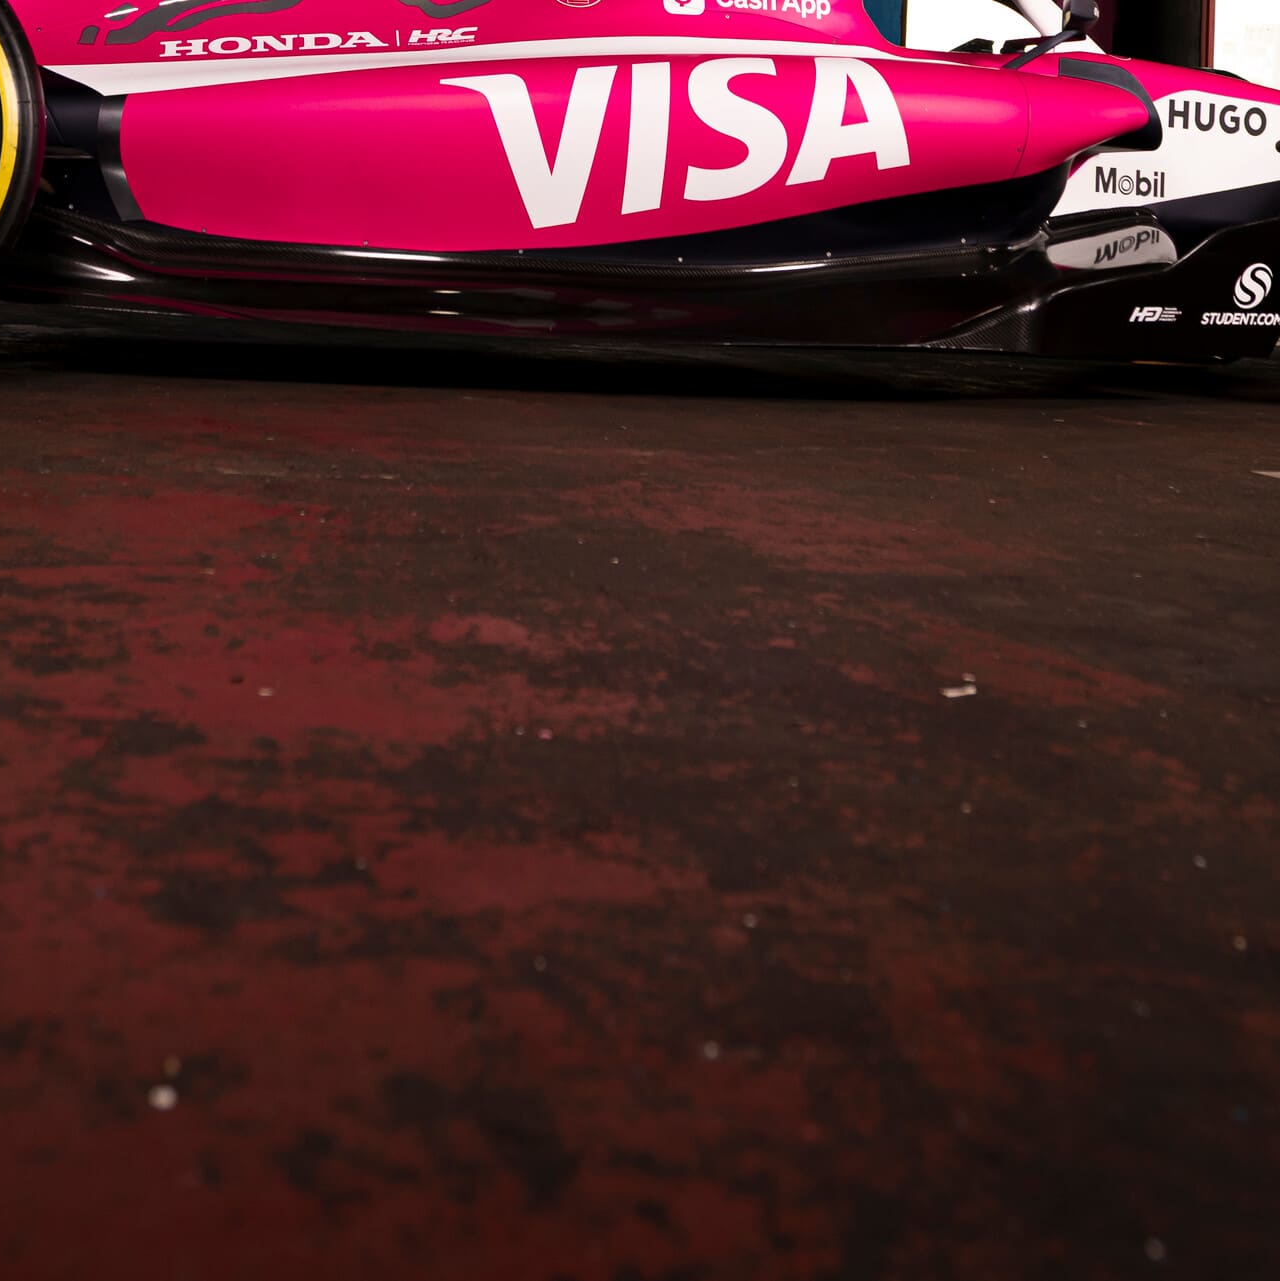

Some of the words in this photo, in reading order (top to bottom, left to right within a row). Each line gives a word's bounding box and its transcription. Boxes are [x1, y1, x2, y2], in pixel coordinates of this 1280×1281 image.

[159, 30, 389, 57] HONDA
[408, 26, 479, 43] HRC
[1167, 99, 1267, 137] HUGO
[439, 57, 911, 229] VISA
[1094, 166, 1165, 198] Mobil
